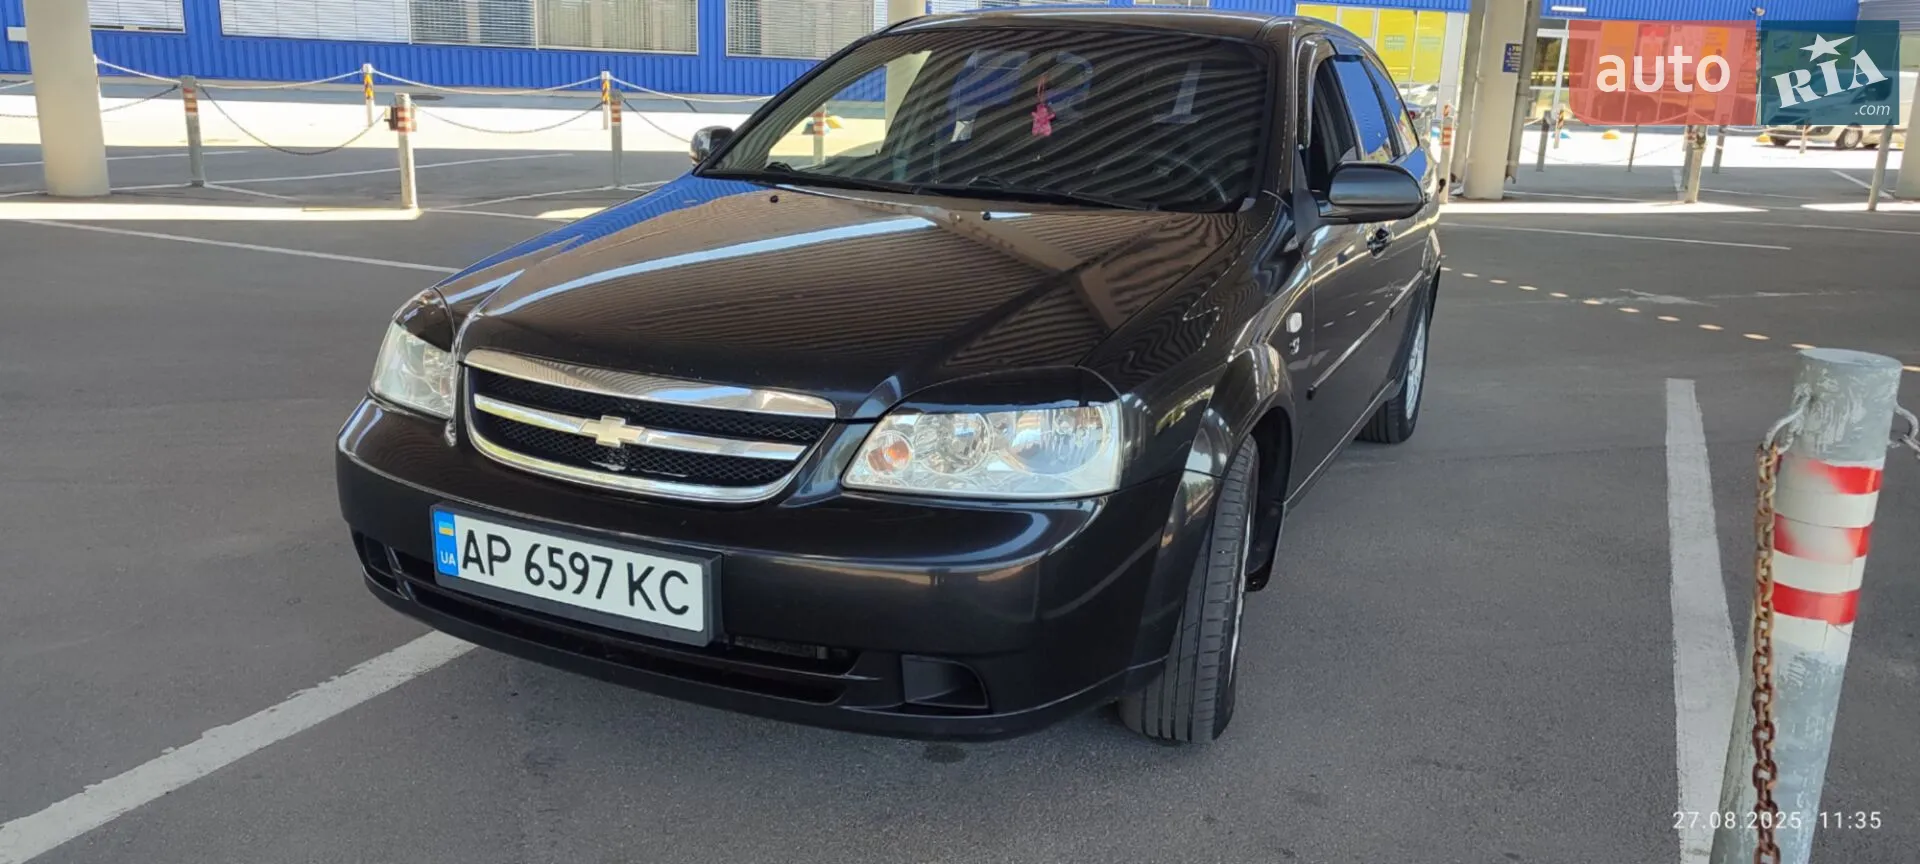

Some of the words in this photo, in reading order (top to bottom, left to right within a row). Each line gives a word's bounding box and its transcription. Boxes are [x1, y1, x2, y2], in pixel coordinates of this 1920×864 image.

[440, 551, 457, 567] UA
[461, 528, 512, 577] AP
[524, 543, 613, 600] 6597
[626, 562, 690, 616] KC
